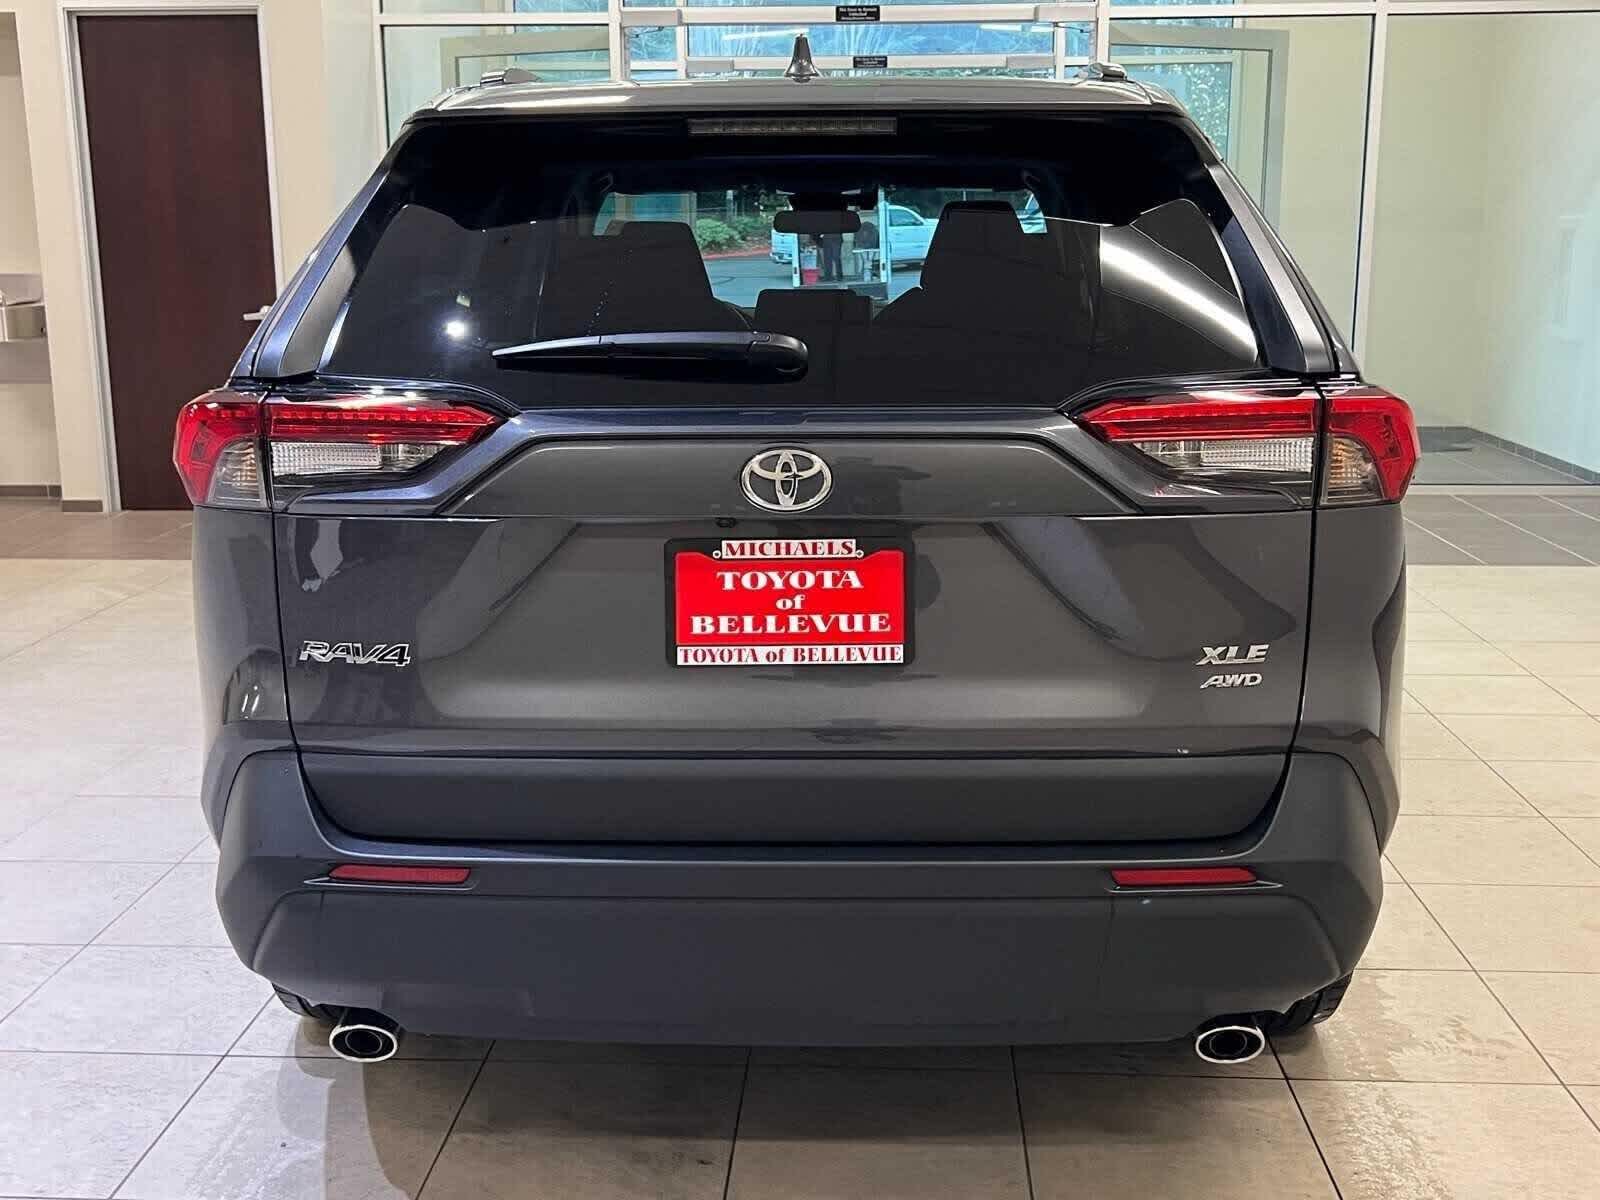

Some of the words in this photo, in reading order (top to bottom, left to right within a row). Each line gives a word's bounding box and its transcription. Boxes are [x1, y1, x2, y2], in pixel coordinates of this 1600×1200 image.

[725, 541, 854, 557] MICHAELS
[716, 570, 864, 591] TOYOTA
[775, 594, 806, 610] of
[690, 613, 891, 635] BELLEVUE
[299, 640, 411, 667] RAV4
[679, 648, 758, 663] TOYOTA
[765, 647, 785, 663] of
[793, 646, 902, 662] BELLEVUE
[1196, 644, 1270, 666] XLE
[1199, 673, 1262, 689] AWD
